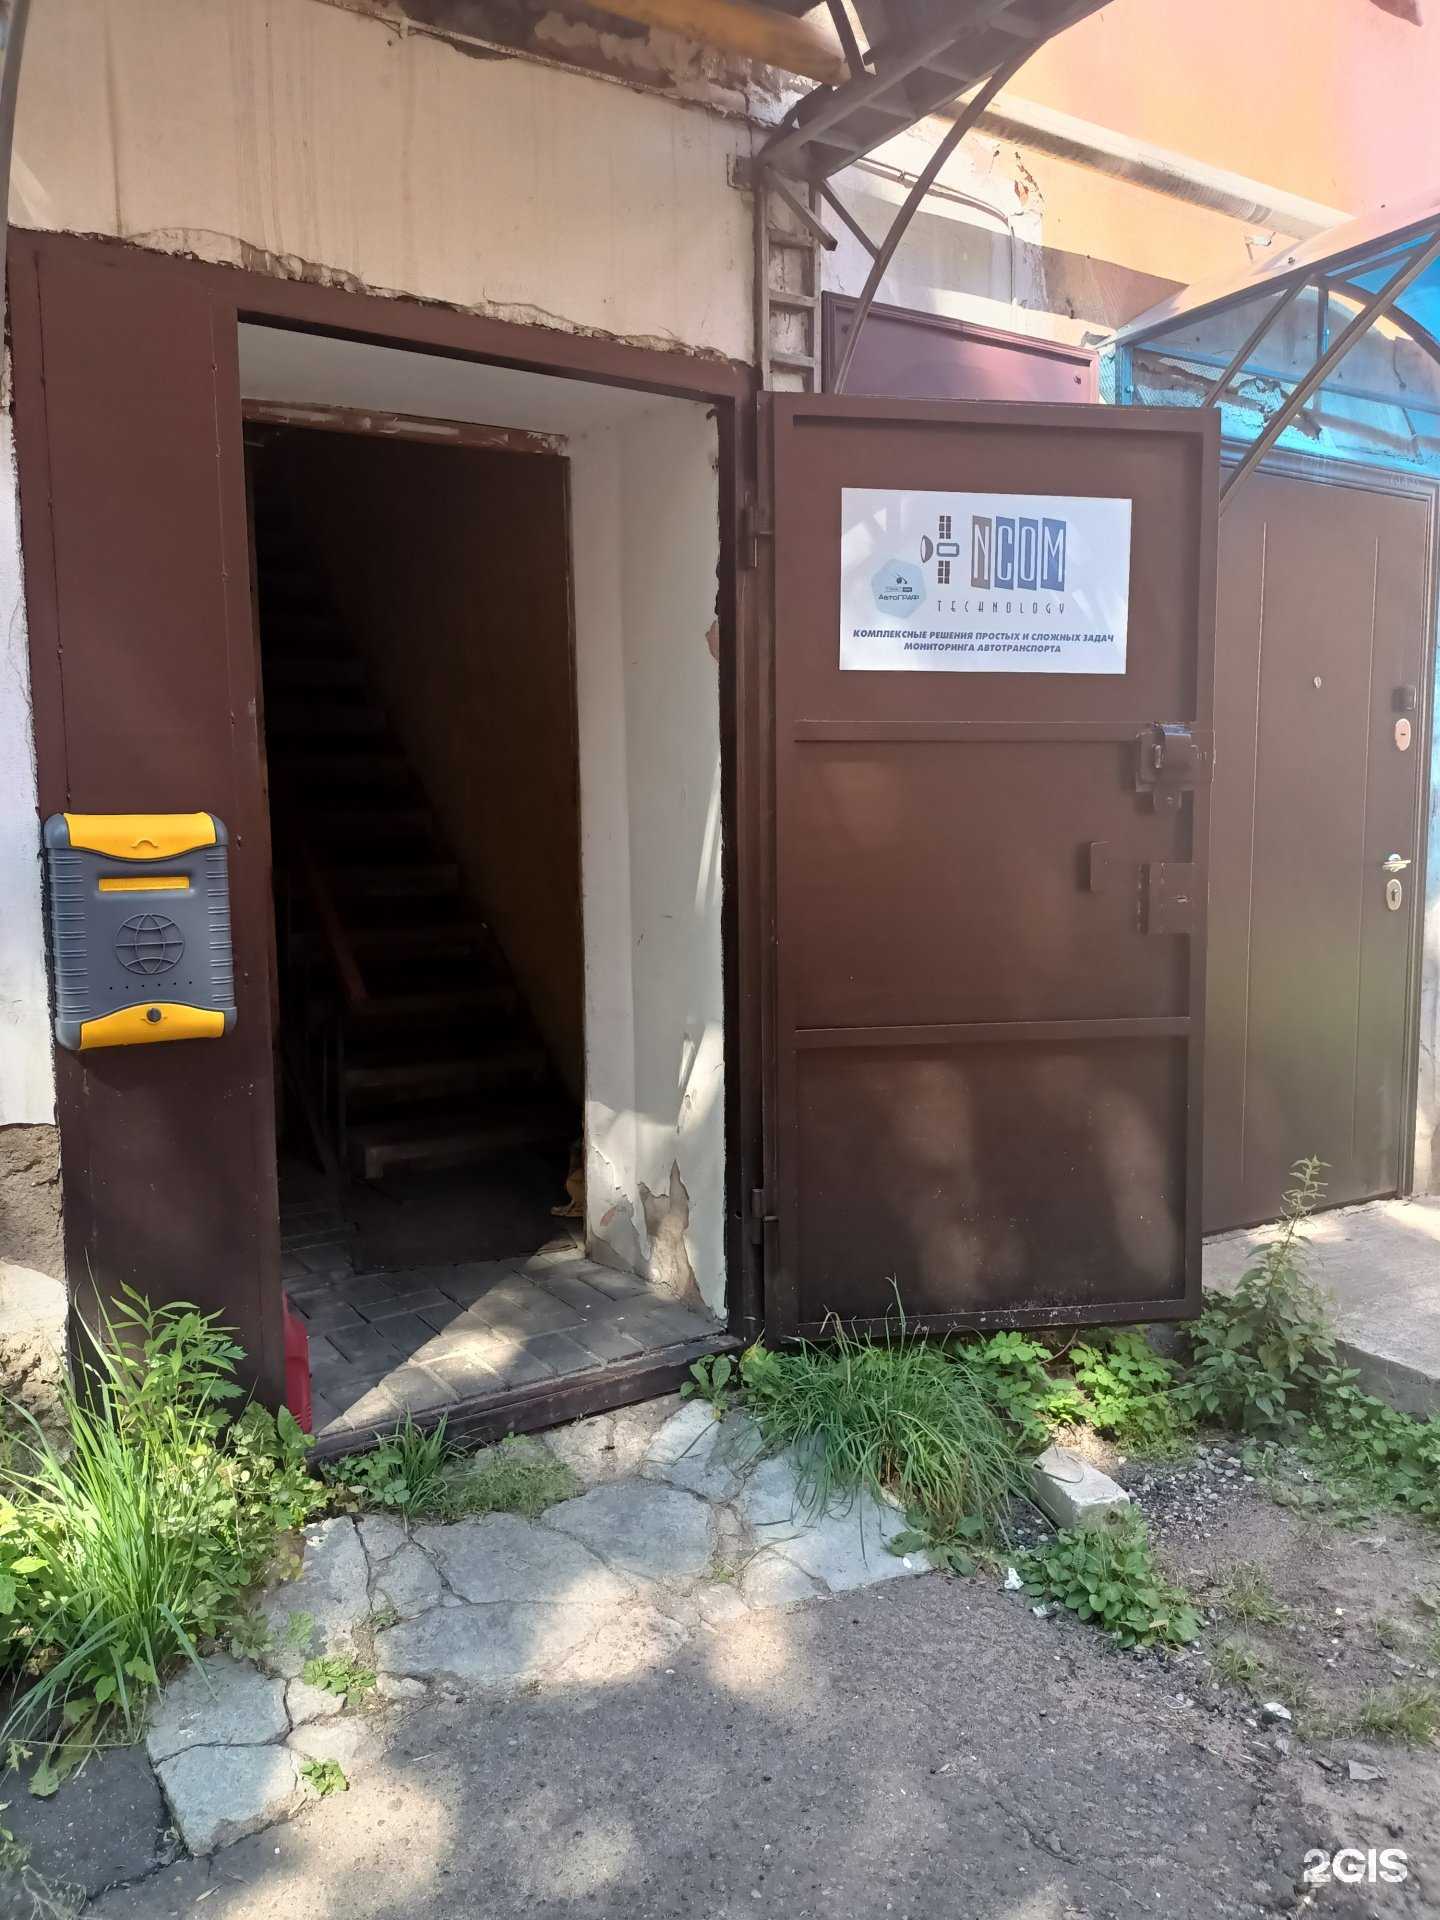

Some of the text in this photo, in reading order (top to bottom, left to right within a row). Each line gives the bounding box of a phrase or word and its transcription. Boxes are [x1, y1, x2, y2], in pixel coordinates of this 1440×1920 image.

[937, 600, 1065, 615] TECHNOLOGY
[853, 629, 1114, 643] КОМПЛЕКСНЫЕ РЕШЕНИЯ ПРОСТЫХ И СЛОЖНЫХ ЗАДАЧ
[904, 642, 1061, 653] МОНИТОРИНГА АВТОТРАНСПОРТА
